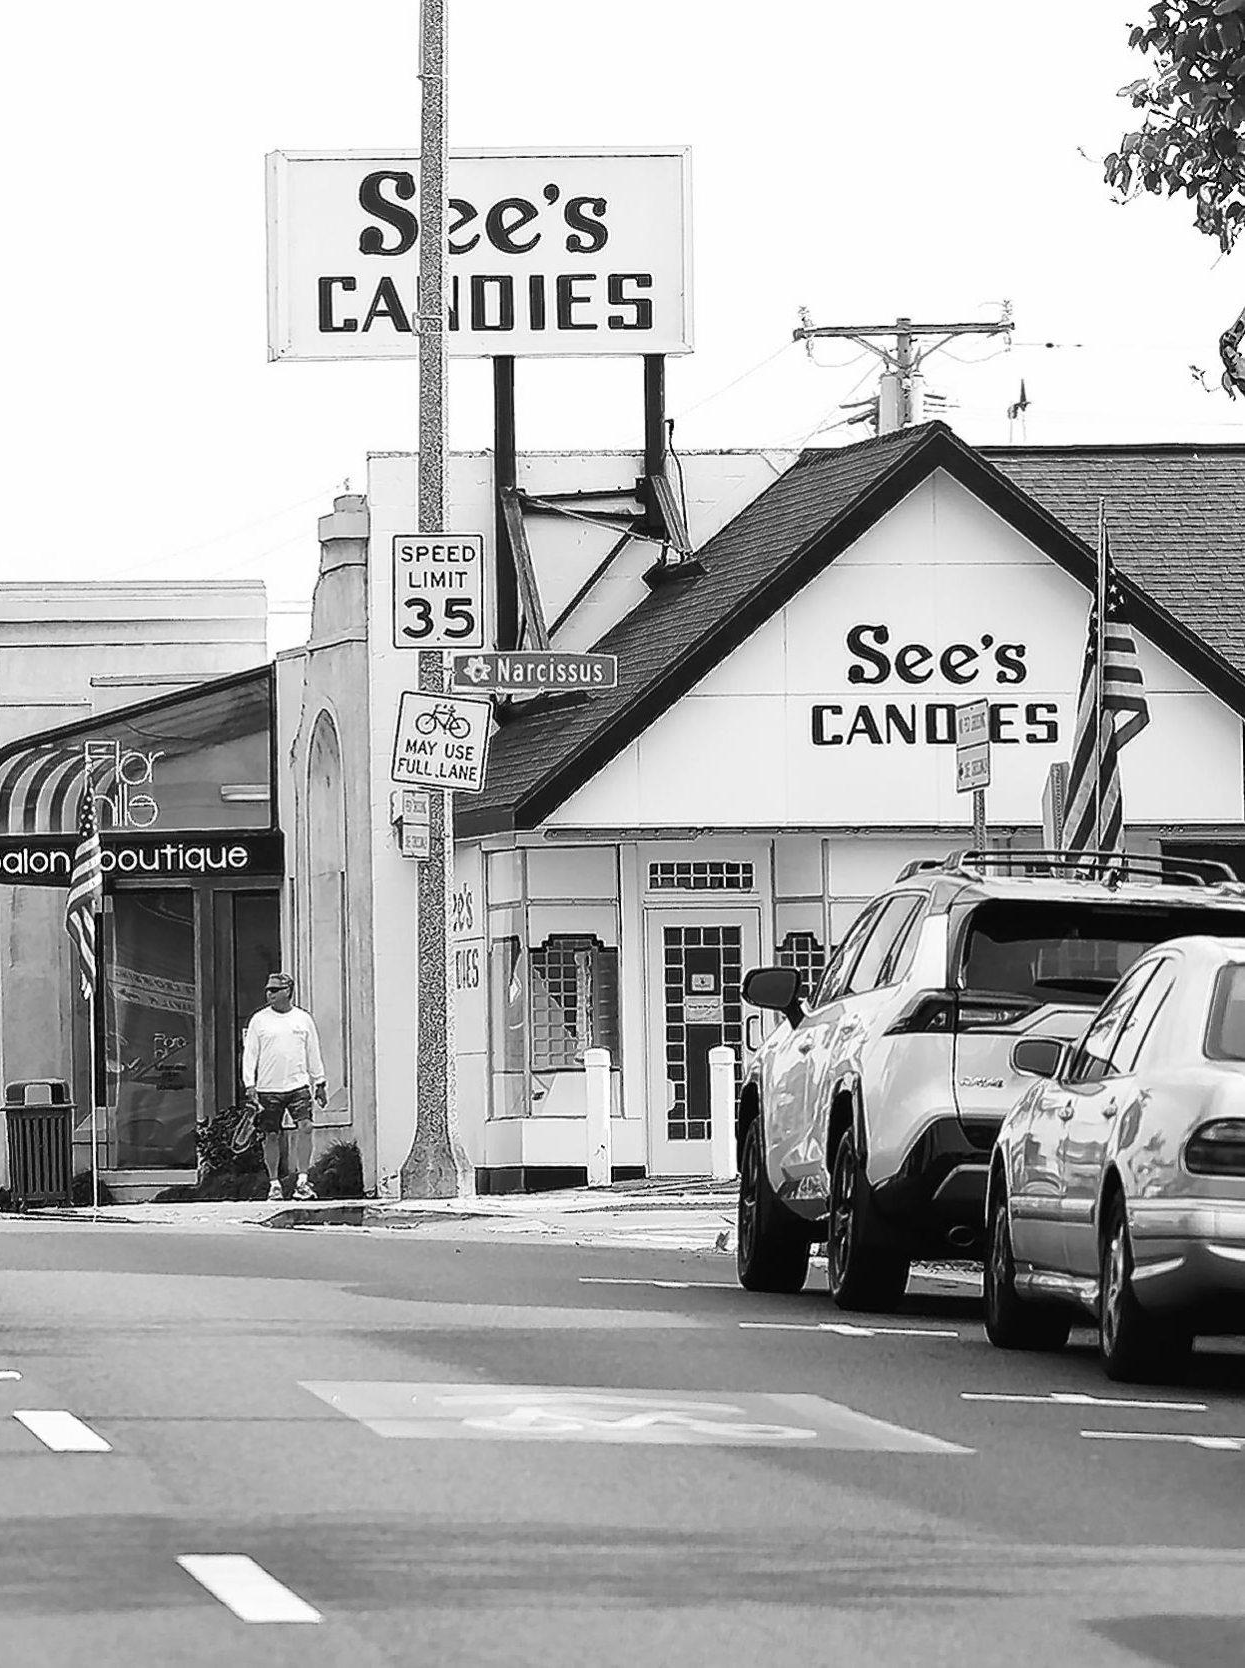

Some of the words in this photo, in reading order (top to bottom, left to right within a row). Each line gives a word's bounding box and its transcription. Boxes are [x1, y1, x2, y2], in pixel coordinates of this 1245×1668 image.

[358, 171, 610, 257] See's
[401, 545, 476, 563] SPEED
[408, 571, 469, 589] LIMIT
[404, 597, 476, 639] 35
[846, 624, 1028, 685] See's
[496, 657, 606, 684] Narcissus
[812, 703, 1059, 745] CANDES
[405, 738, 439, 755] MAY
[444, 743, 476, 762] USE
[396, 757, 433, 778] FULL
[439, 762, 478, 783] LANE
